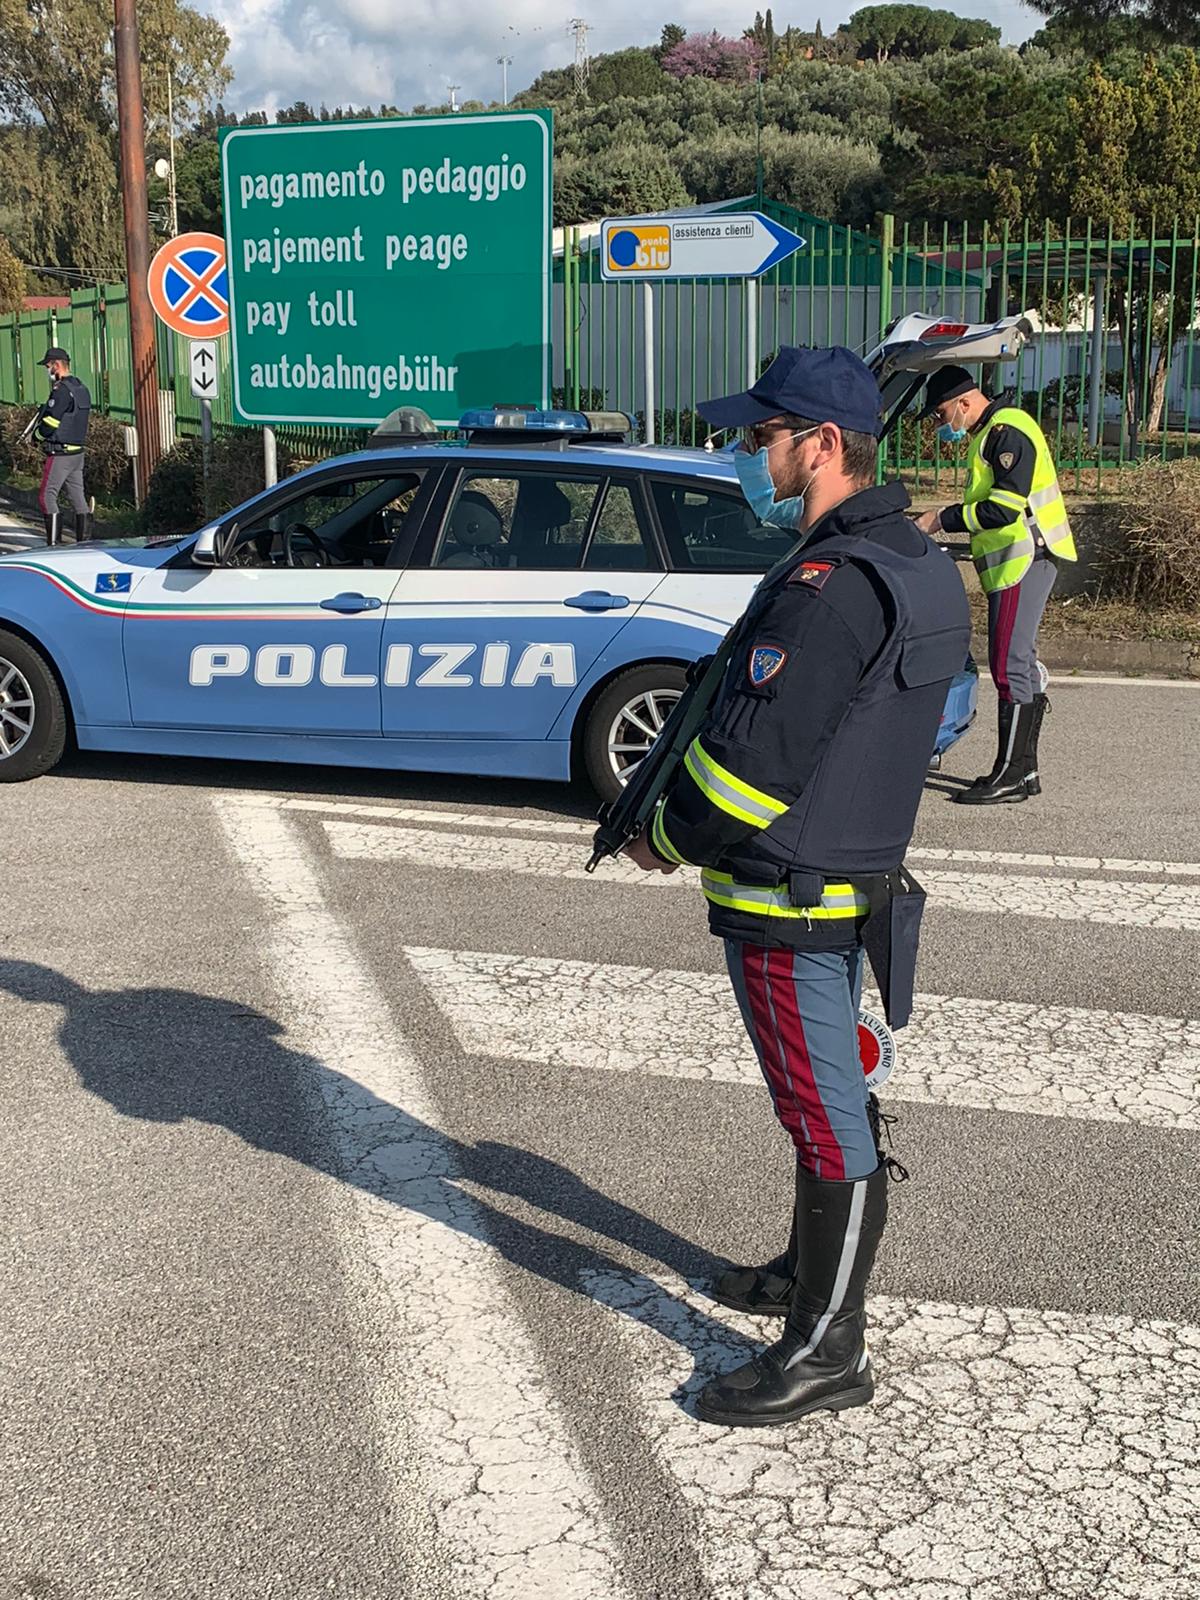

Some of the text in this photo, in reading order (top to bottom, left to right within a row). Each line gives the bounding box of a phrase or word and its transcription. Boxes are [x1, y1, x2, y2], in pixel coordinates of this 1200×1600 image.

[240, 154, 527, 208] pagamento pedaggio
[243, 226, 467, 274] pajement peage
[641, 236, 669, 247] punto
[675, 224, 751, 238] assistenza clienti
[635, 245, 669, 267] blu
[247, 290, 357, 335] pay toll
[250, 354, 458, 399] autobahngebühr
[188, 643, 578, 687] POLIZIA
